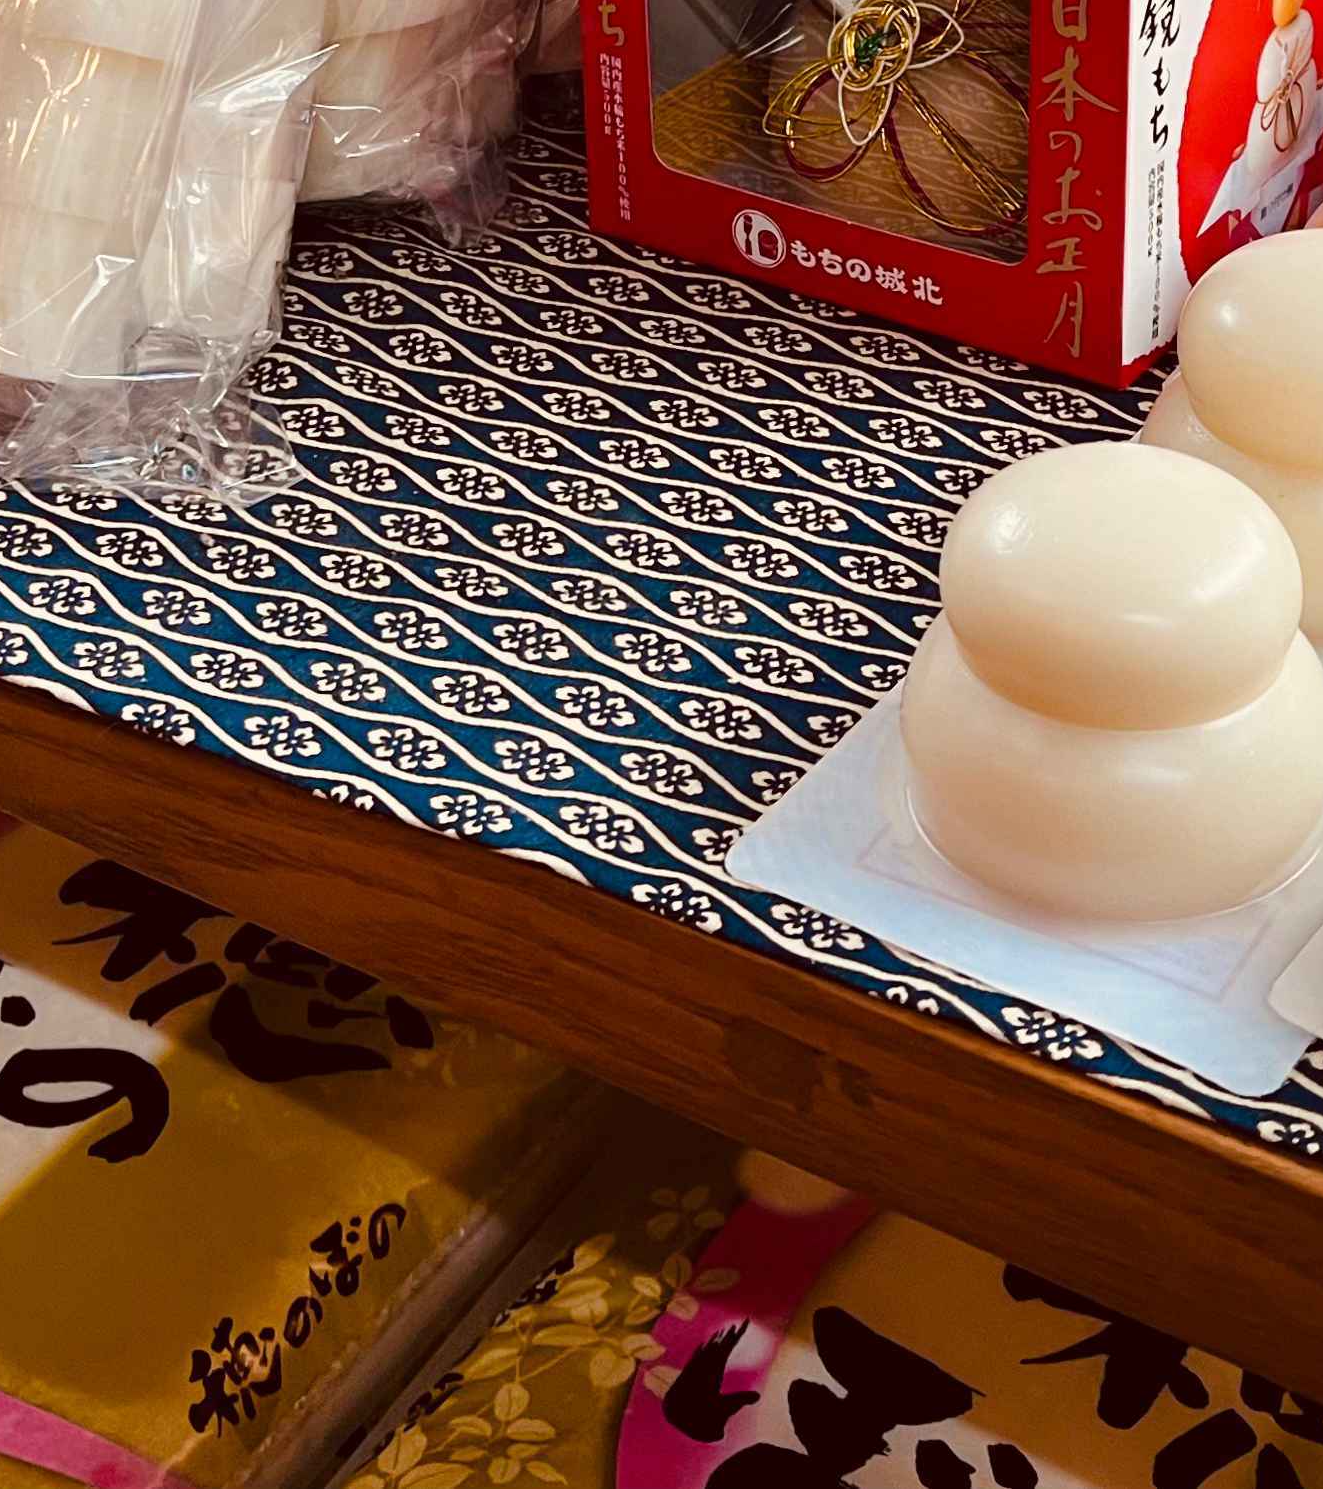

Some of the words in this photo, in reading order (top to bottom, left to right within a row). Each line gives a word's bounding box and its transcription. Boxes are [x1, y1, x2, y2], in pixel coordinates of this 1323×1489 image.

[789, 238, 944, 307] もちの城北
